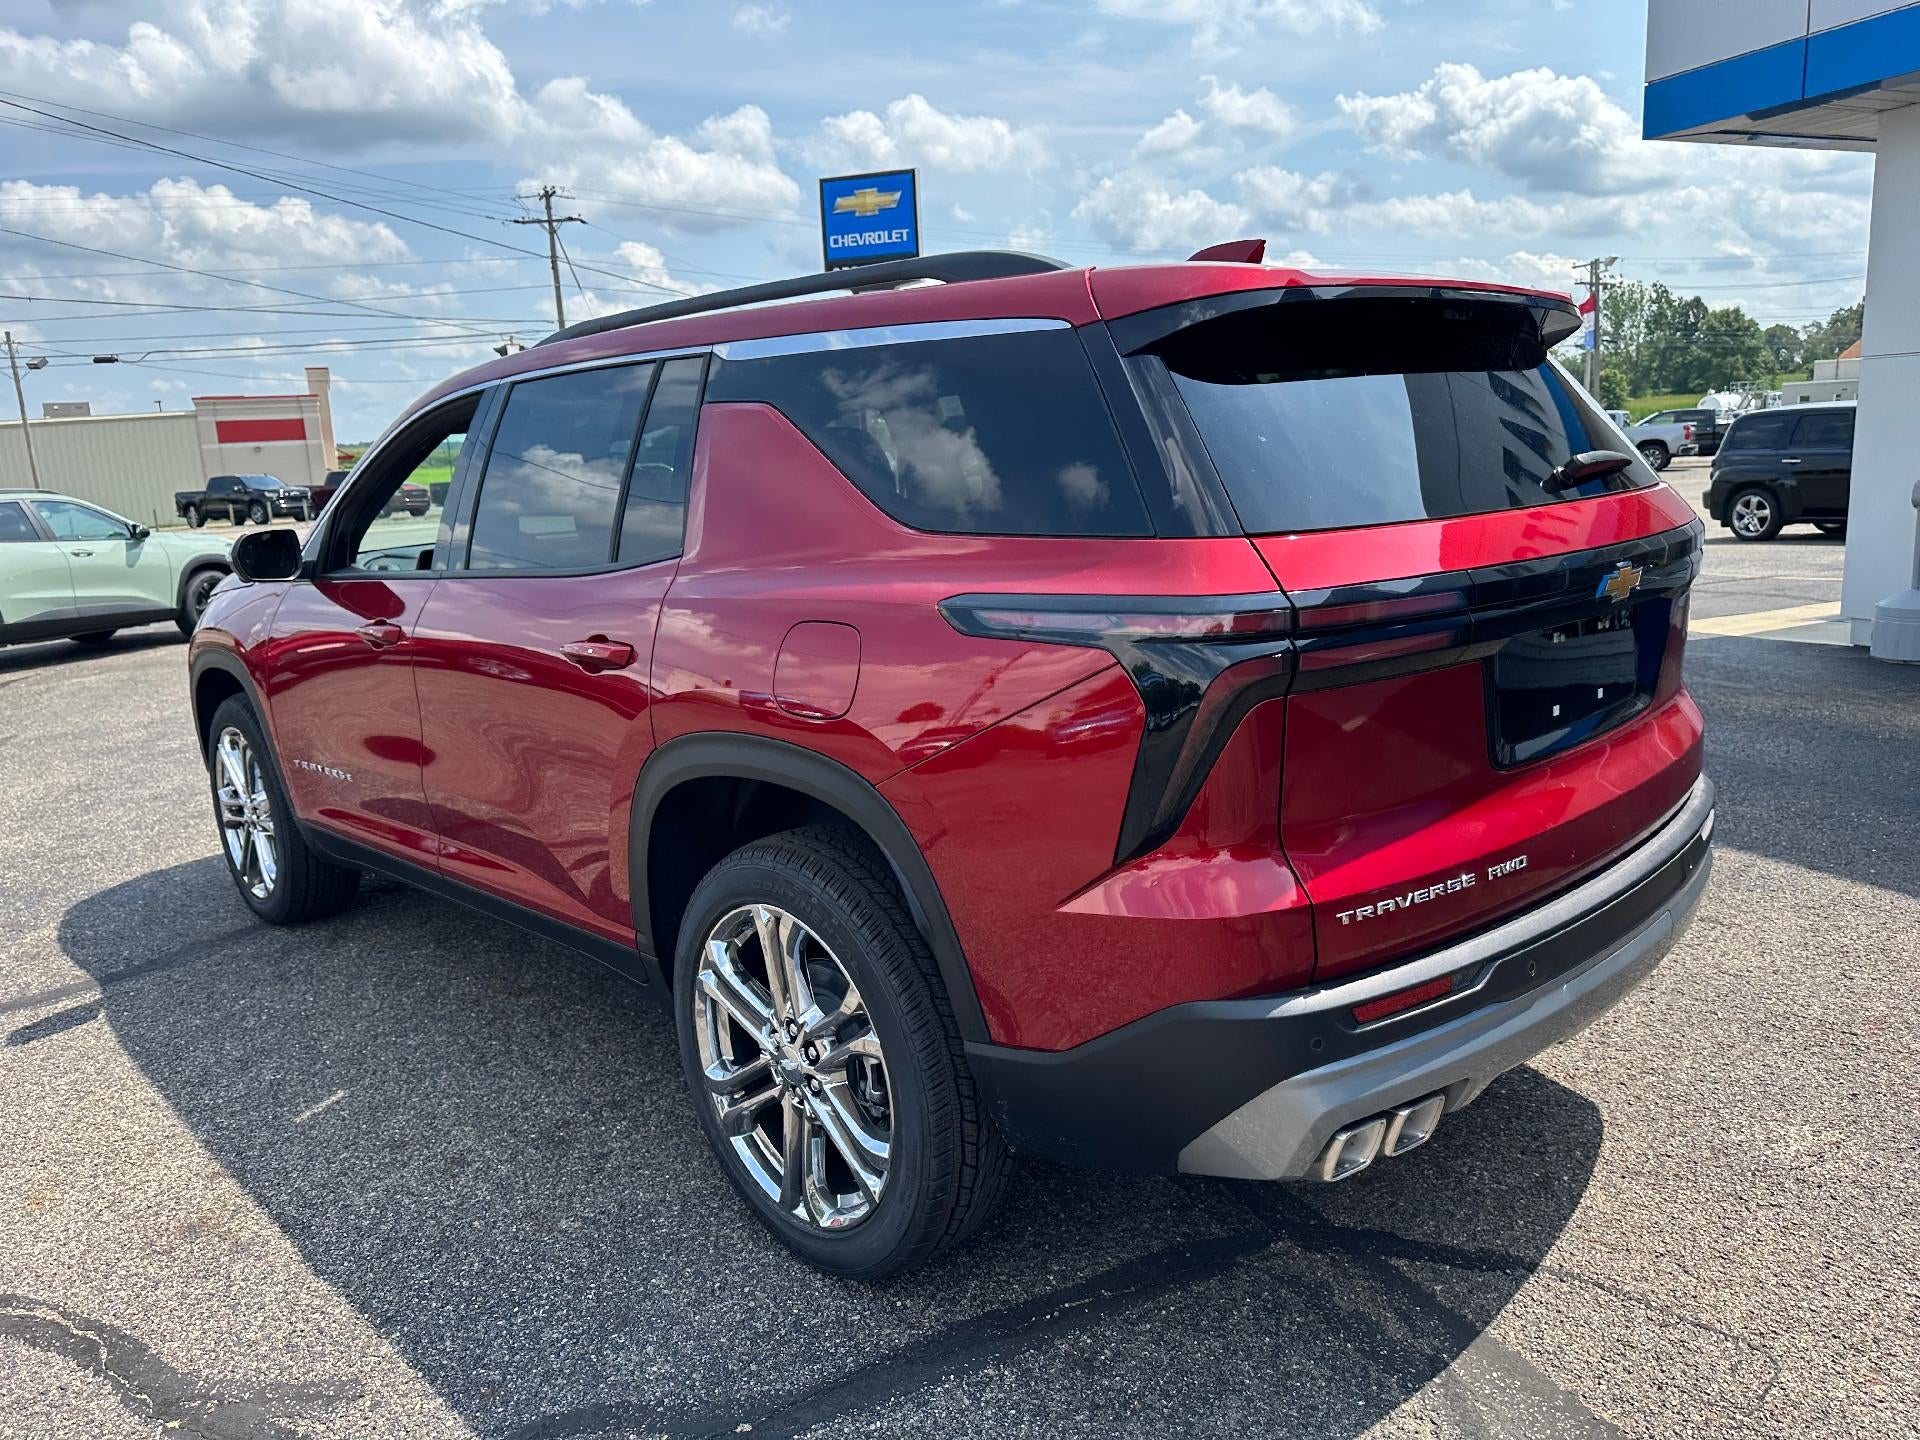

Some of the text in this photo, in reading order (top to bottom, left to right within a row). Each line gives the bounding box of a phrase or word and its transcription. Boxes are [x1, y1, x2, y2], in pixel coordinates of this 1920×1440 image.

[829, 229, 909, 248] CHEVROLET
[293, 759, 353, 782] TRAVERSE
[1335, 854, 1528, 926] TRAVERSE AWD
